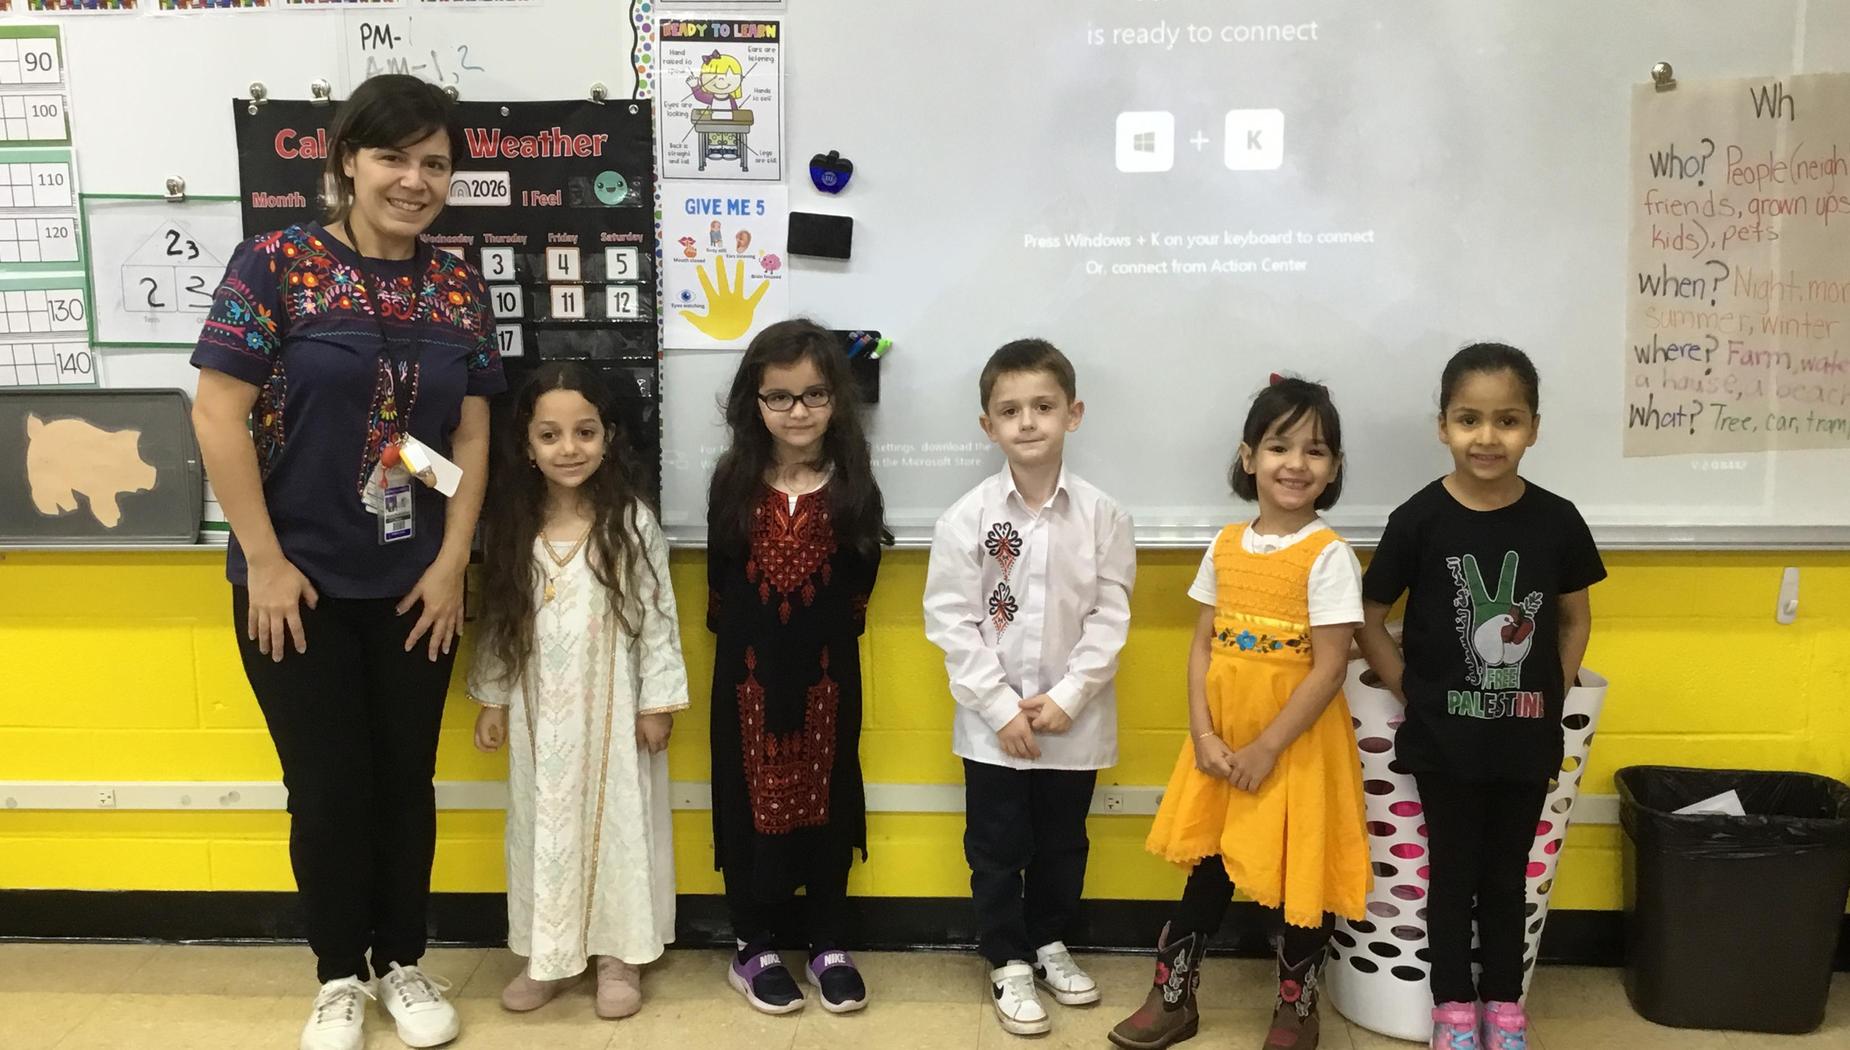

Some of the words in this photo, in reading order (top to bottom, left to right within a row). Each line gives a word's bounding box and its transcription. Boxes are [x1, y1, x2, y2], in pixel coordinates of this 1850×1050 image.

[662, 22, 707, 38] READY
[712, 23, 731, 38] TO
[734, 23, 776, 39] LEARN
[1087, 21, 1104, 45] is
[1112, 20, 1180, 50] ready
[1187, 23, 1212, 43] to
[1220, 20, 1319, 42] connect
[25, 52, 52, 71] 90
[32, 104, 58, 117] 100
[1750, 82, 1795, 121] Wh
[274, 127, 328, 159] Cal
[465, 127, 608, 159] Weather
[1247, 130, 1262, 150] K
[38, 173, 64, 186] 110
[472, 180, 507, 198] 2026
[252, 191, 306, 208] Month
[522, 190, 529, 206] I
[531, 190, 562, 207] Feel
[685, 199, 722, 216] GIVE
[727, 199, 751, 216] ME
[756, 199, 765, 216] 5
[1643, 188, 1743, 219] friends,
[1748, 196, 1807, 225] grown
[45, 227, 68, 239] 120
[420, 233, 474, 246] Wednesday
[483, 233, 528, 246] Thursday
[548, 232, 579, 245] Friday
[600, 231, 644, 244] Saturday
[1024, 233, 1060, 248] Press
[1064, 232, 1131, 248] Windows
[1151, 232, 1160, 246] K
[1164, 235, 1182, 246] on
[1187, 235, 1219, 251] your
[1224, 230, 1292, 251] keyboard
[1297, 231, 1313, 245] to
[1317, 229, 1374, 244] connect
[1652, 219, 1716, 259] kids),
[1722, 221, 1779, 250] pets
[165, 229, 200, 260] 23
[492, 254, 504, 275] 3
[558, 253, 569, 274] 4
[616, 253, 627, 275] 5
[1112, 260, 1167, 275] connect
[1172, 260, 1206, 274] from
[1211, 259, 1257, 273] Action
[1262, 257, 1308, 273] Center
[140, 277, 165, 308] 2
[186, 276, 214, 308] 3
[496, 292, 517, 313] 10
[561, 292, 575, 313] 11
[614, 292, 631, 313] 12
[48, 298, 84, 322] 130
[498, 330, 514, 351] 17
[57, 352, 92, 374] 140
[1635, 333, 1719, 376] where?
[1663, 366, 1743, 400] house,
[1710, 403, 1757, 433] Tree,
[1765, 413, 1799, 434] car,
[921, 442, 972, 452] download
[902, 456, 951, 467] Microsoft
[1487, 667, 1518, 690] FREE
[760, 953, 781, 968] NIKE
[824, 953, 846, 967] NIKE
